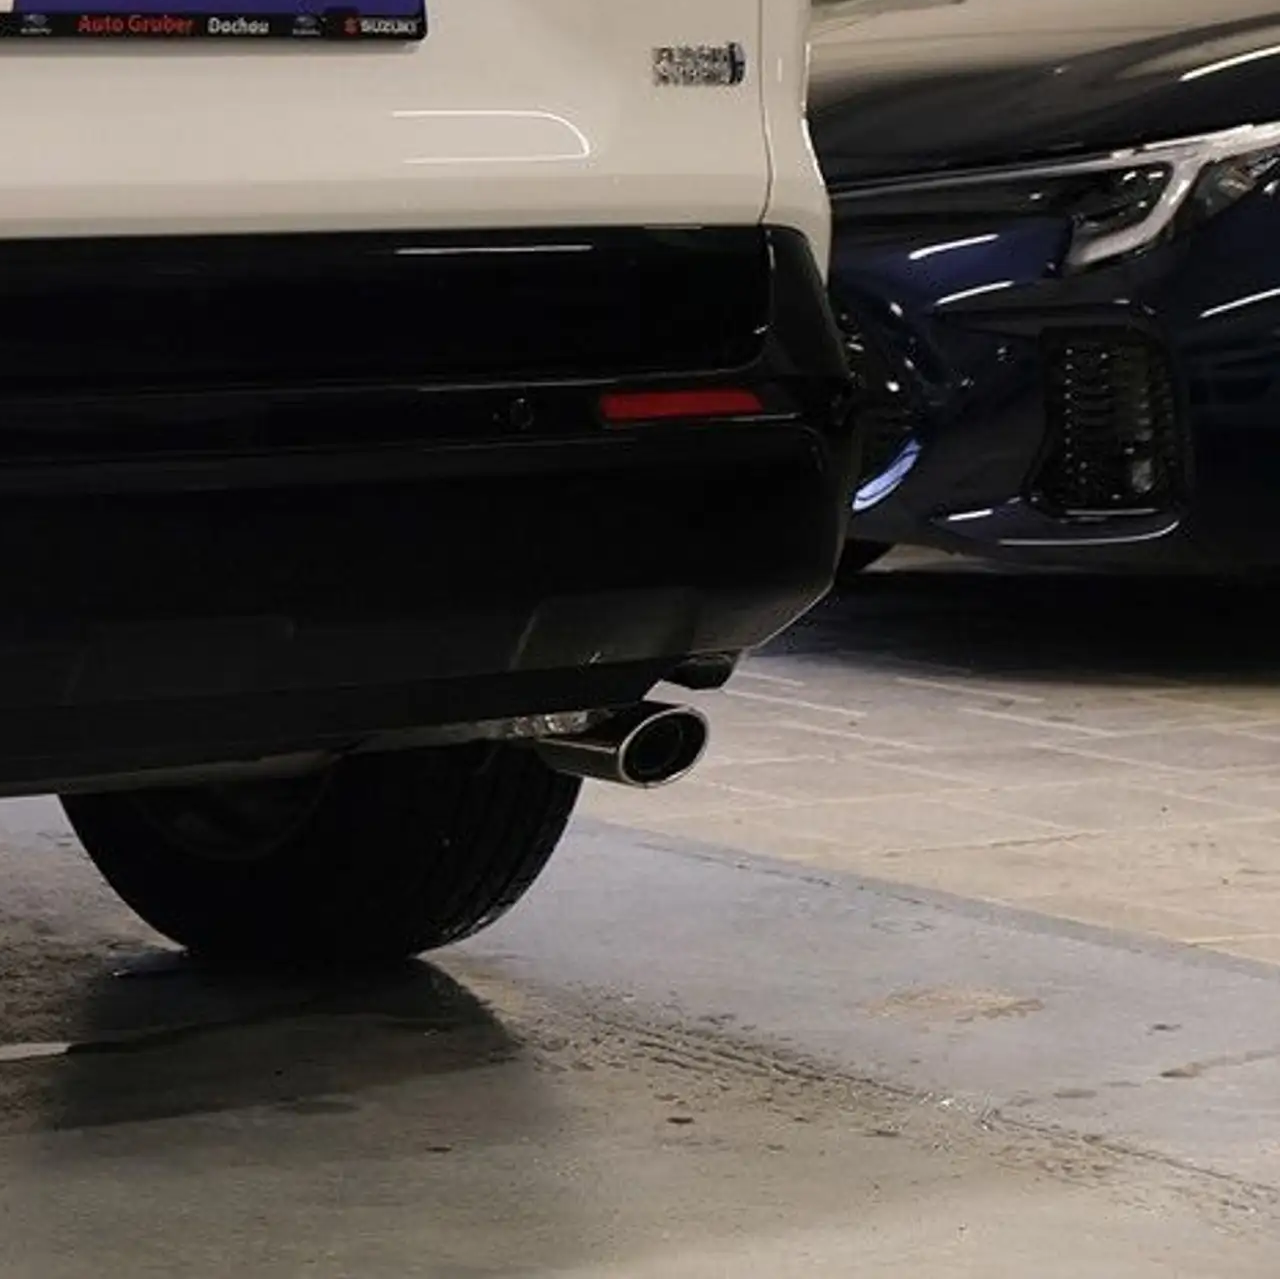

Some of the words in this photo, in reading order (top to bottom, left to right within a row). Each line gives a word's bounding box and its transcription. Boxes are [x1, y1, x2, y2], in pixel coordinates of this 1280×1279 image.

[78, 16, 125, 32] Auto
[128, 16, 195, 34] Gruber
[207, 17, 270, 35] Dachau
[361, 19, 418, 34] SUZUKI
